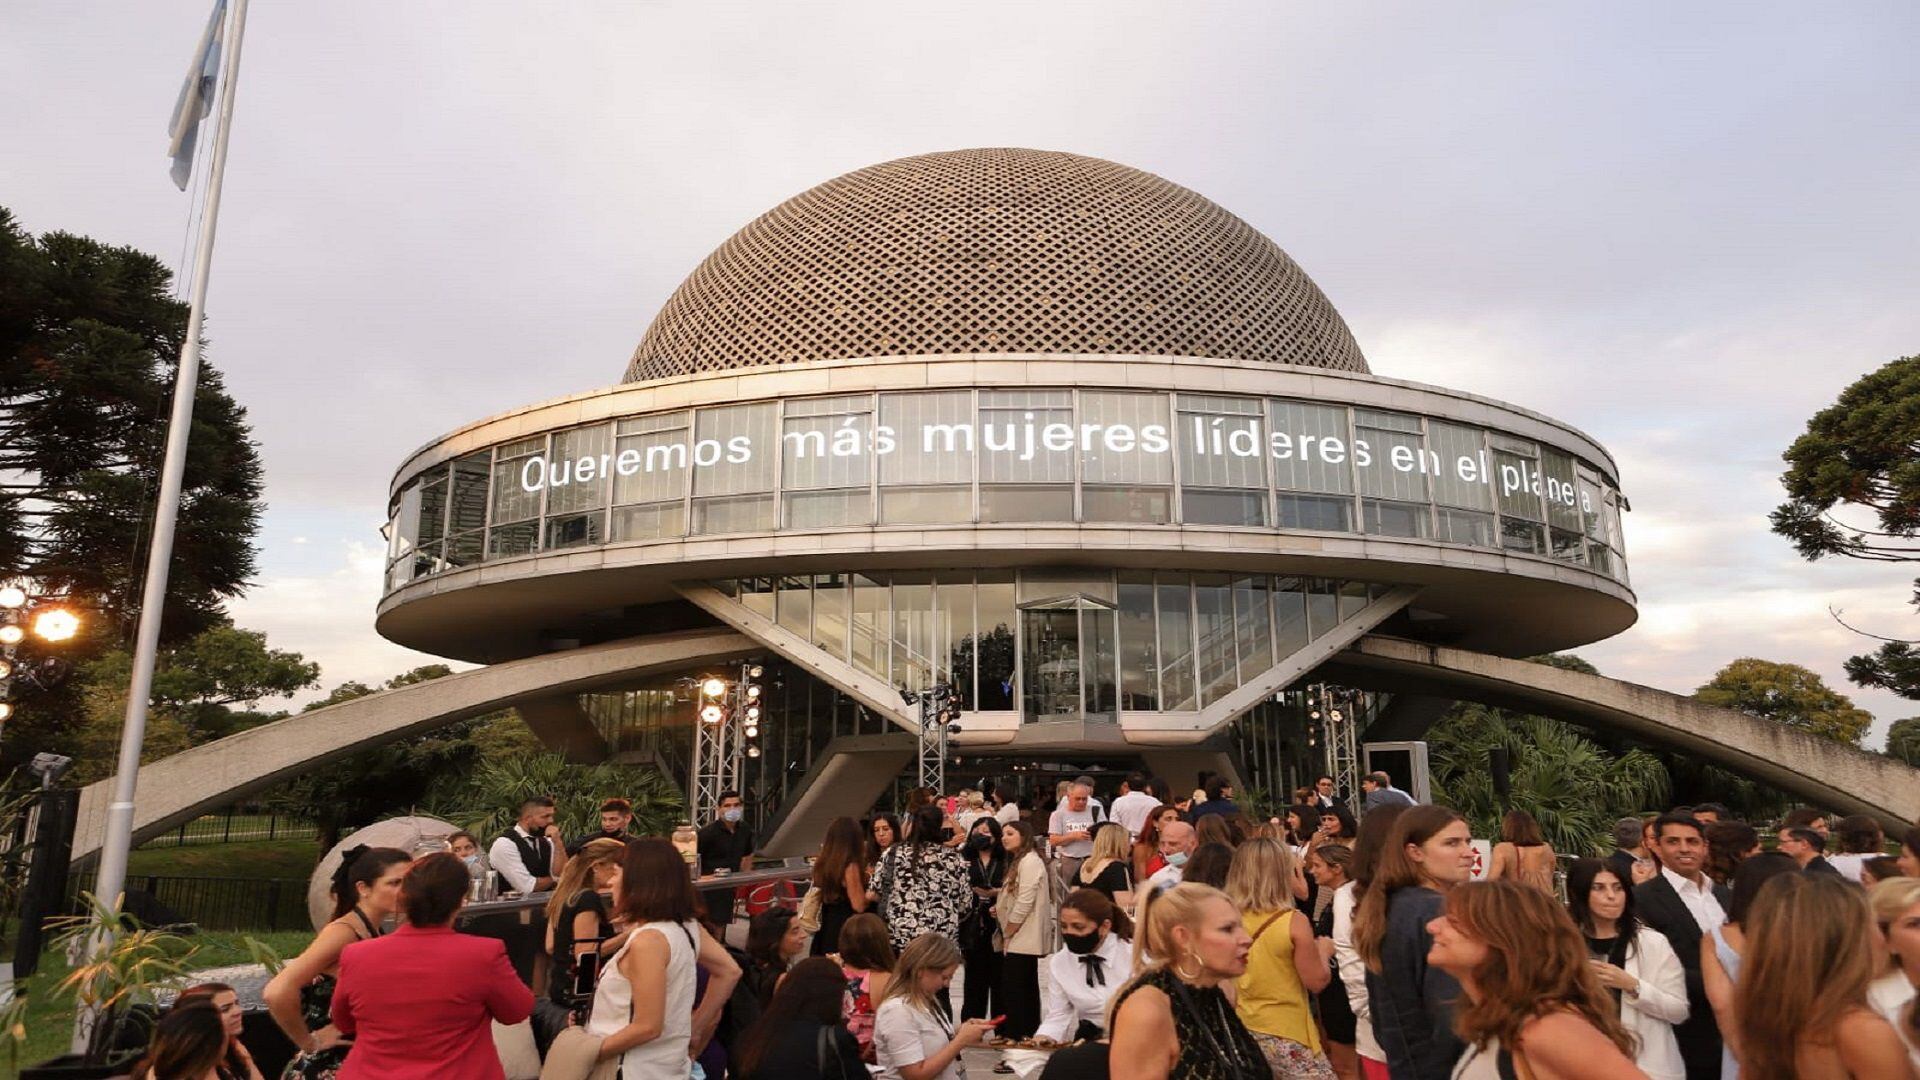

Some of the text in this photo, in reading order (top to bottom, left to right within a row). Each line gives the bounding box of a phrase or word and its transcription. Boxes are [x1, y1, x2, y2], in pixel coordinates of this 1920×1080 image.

[522, 413, 1592, 513] Queremos más mujeres líderes en el planea
